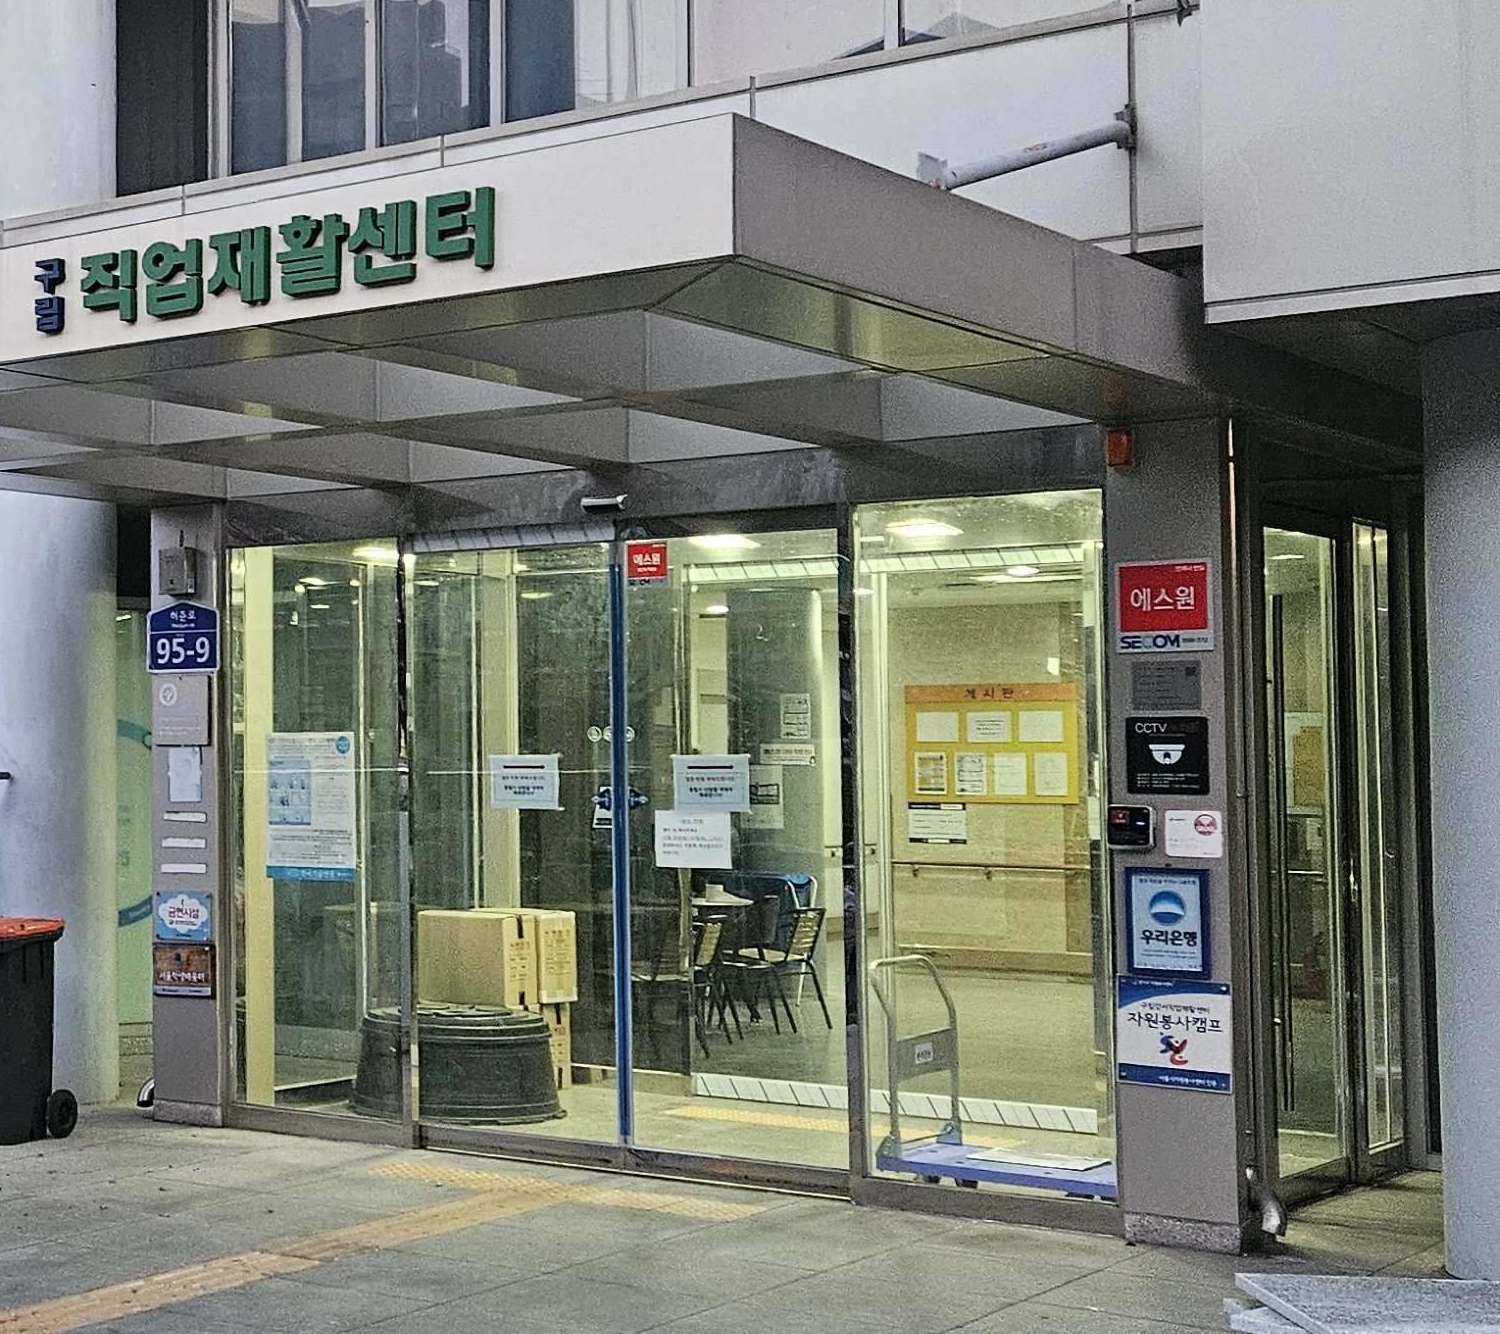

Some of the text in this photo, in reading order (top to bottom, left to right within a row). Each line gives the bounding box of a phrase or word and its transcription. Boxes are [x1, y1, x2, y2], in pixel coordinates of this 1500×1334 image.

[33, 185, 496, 334] 구립 직업재활센터
[632, 552, 661, 566] 에스원
[1130, 586, 1195, 612] 에스원
[170, 610, 197, 622] 허준로
[156, 636, 210, 664] 95-9
[1120, 634, 1180, 649] SECOM
[1135, 722, 1168, 734] CCTV
[1140, 929, 1198, 947] 우리은행
[1127, 1012, 1224, 1034] 자원봉사캠프
